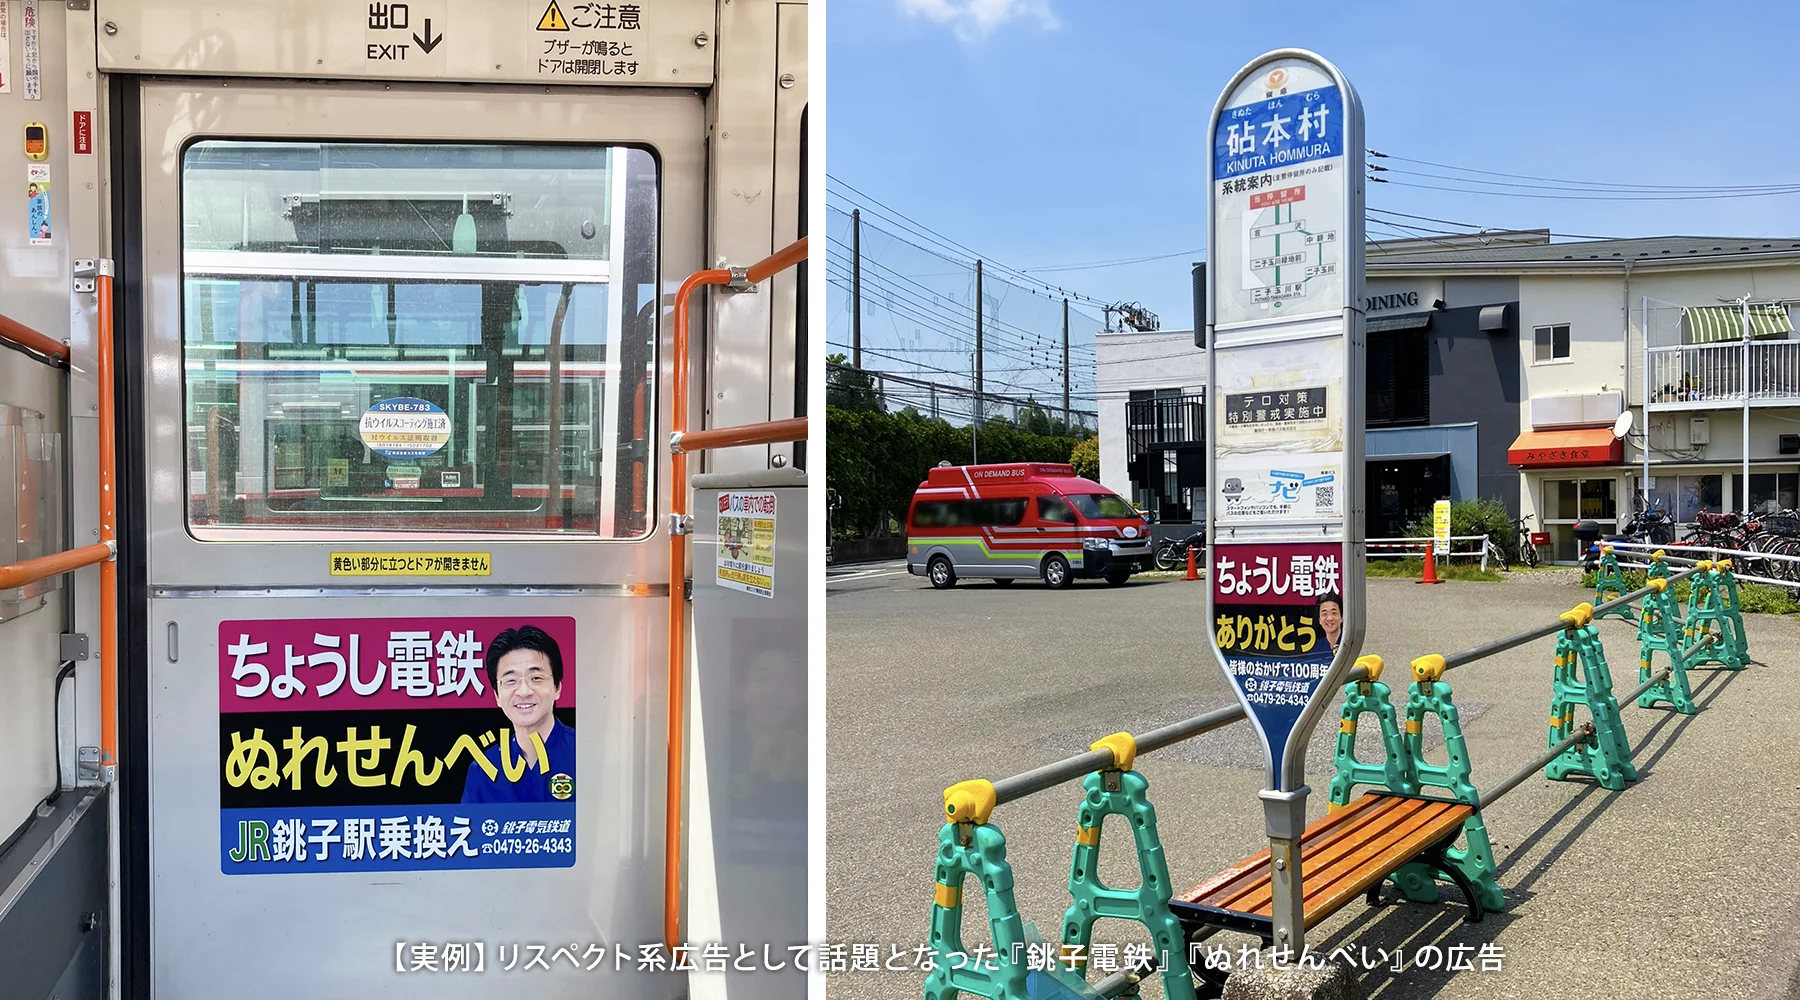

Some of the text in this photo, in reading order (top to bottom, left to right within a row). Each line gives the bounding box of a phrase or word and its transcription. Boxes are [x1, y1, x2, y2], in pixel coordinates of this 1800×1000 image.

[25, 7, 35, 28] 危険
[368, 2, 409, 30] 出口
[571, 4, 641, 31] ご注意
[367, 45, 409, 60] EXIT
[543, 40, 633, 57] ブザーが鳴ると
[537, 59, 639, 76] ドアは開閉します
[1231, 92, 1320, 119] きぬた はん むら
[79, 114, 87, 151] ドアに注意
[1226, 103, 1330, 157] 砧本村
[1226, 142, 1331, 174] KINUTA HOMMURA
[1222, 174, 1272, 195] 系統案内
[1306, 265, 1334, 276] 二子玉川
[1254, 283, 1302, 297] 二子玉川駅
[379, 403, 431, 412] SKYBE-783
[1244, 391, 1308, 408] テロ対策
[1228, 405, 1324, 423] 特別警戒実施中
[364, 417, 446, 430] 抗ウイルスコーティング施工済
[1526, 450, 1591, 461] みやざき食堂
[974, 469, 1025, 479] ON DEMAND BUS
[333, 557, 488, 571] 黄色い部分に立つとドアが開きません
[1216, 554, 1340, 597] ちょうし電鉄
[1216, 613, 1317, 653] ありがとう
[228, 629, 485, 699] ちょうし電鉄
[1229, 659, 1329, 679] 皆様のおかげで100周年
[1253, 692, 1309, 706] 0479-26-4343
[225, 723, 550, 791] ぬれせんべい
[500, 818, 572, 835] 銚子電気鉄道
[229, 815, 479, 862] JR銚子駅乗換え
[493, 837, 572, 855] 0479-26-4343
